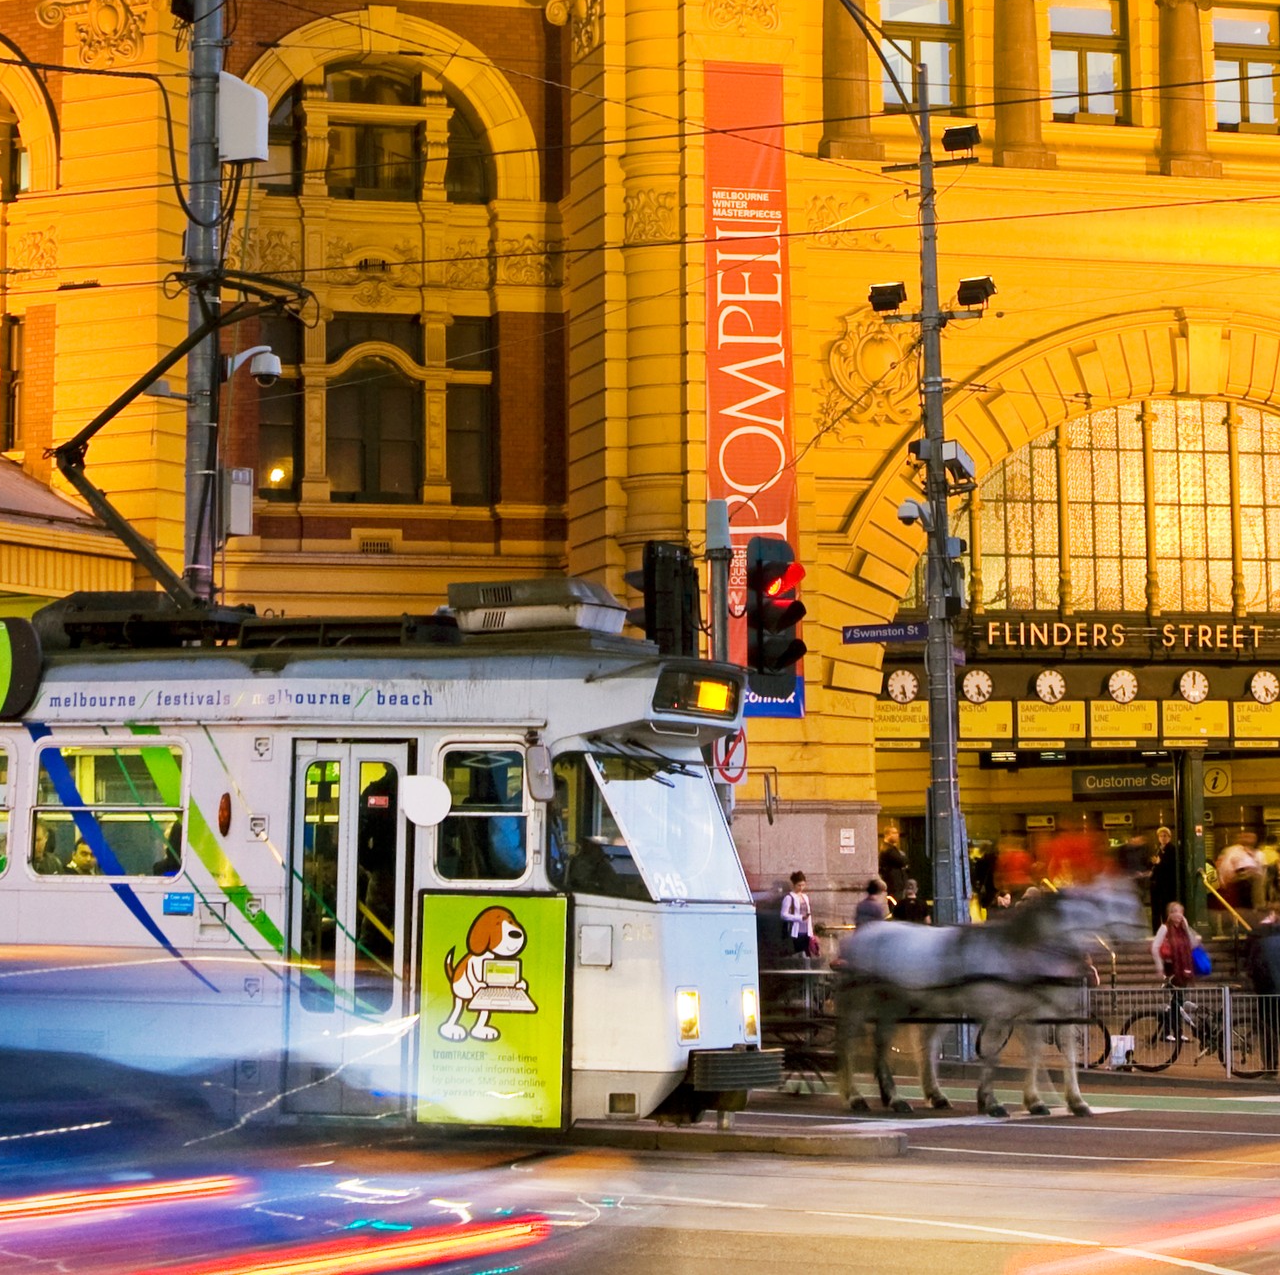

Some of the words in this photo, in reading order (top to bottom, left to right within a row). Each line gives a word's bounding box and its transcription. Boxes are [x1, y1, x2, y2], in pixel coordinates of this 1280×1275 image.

[712, 191, 769, 201] MELBOURNE
[712, 199, 748, 209] WINTER
[712, 208, 782, 218] MASTERPIECES
[716, 224, 788, 542] POMPEII
[853, 626, 905, 638] Swanston
[907, 625, 919, 636] St
[987, 621, 1125, 647] FLINDERS
[1162, 623, 1265, 649] STREET
[49, 691, 136, 708] melbourne
[156, 689, 231, 706] festivals
[251, 688, 351, 706] melbourne
[376, 689, 433, 706] beach
[1094, 704, 1146, 712] WILLIAMSTOWN
[1166, 704, 1192, 712] ALTONA
[1020, 714, 1036, 722] LINE
[1094, 714, 1109, 722] LINE
[1166, 714, 1182, 722] LINE
[1086, 775, 1147, 788] Customer
[654, 871, 689, 898] 215
[498, 1053, 538, 1062] real-time
[432, 1064, 454, 1072] tram
[456, 1064, 483, 1074] arrival
[485, 1065, 538, 1074] information
[498, 1077, 516, 1086] and
[518, 1078, 546, 1088] online
